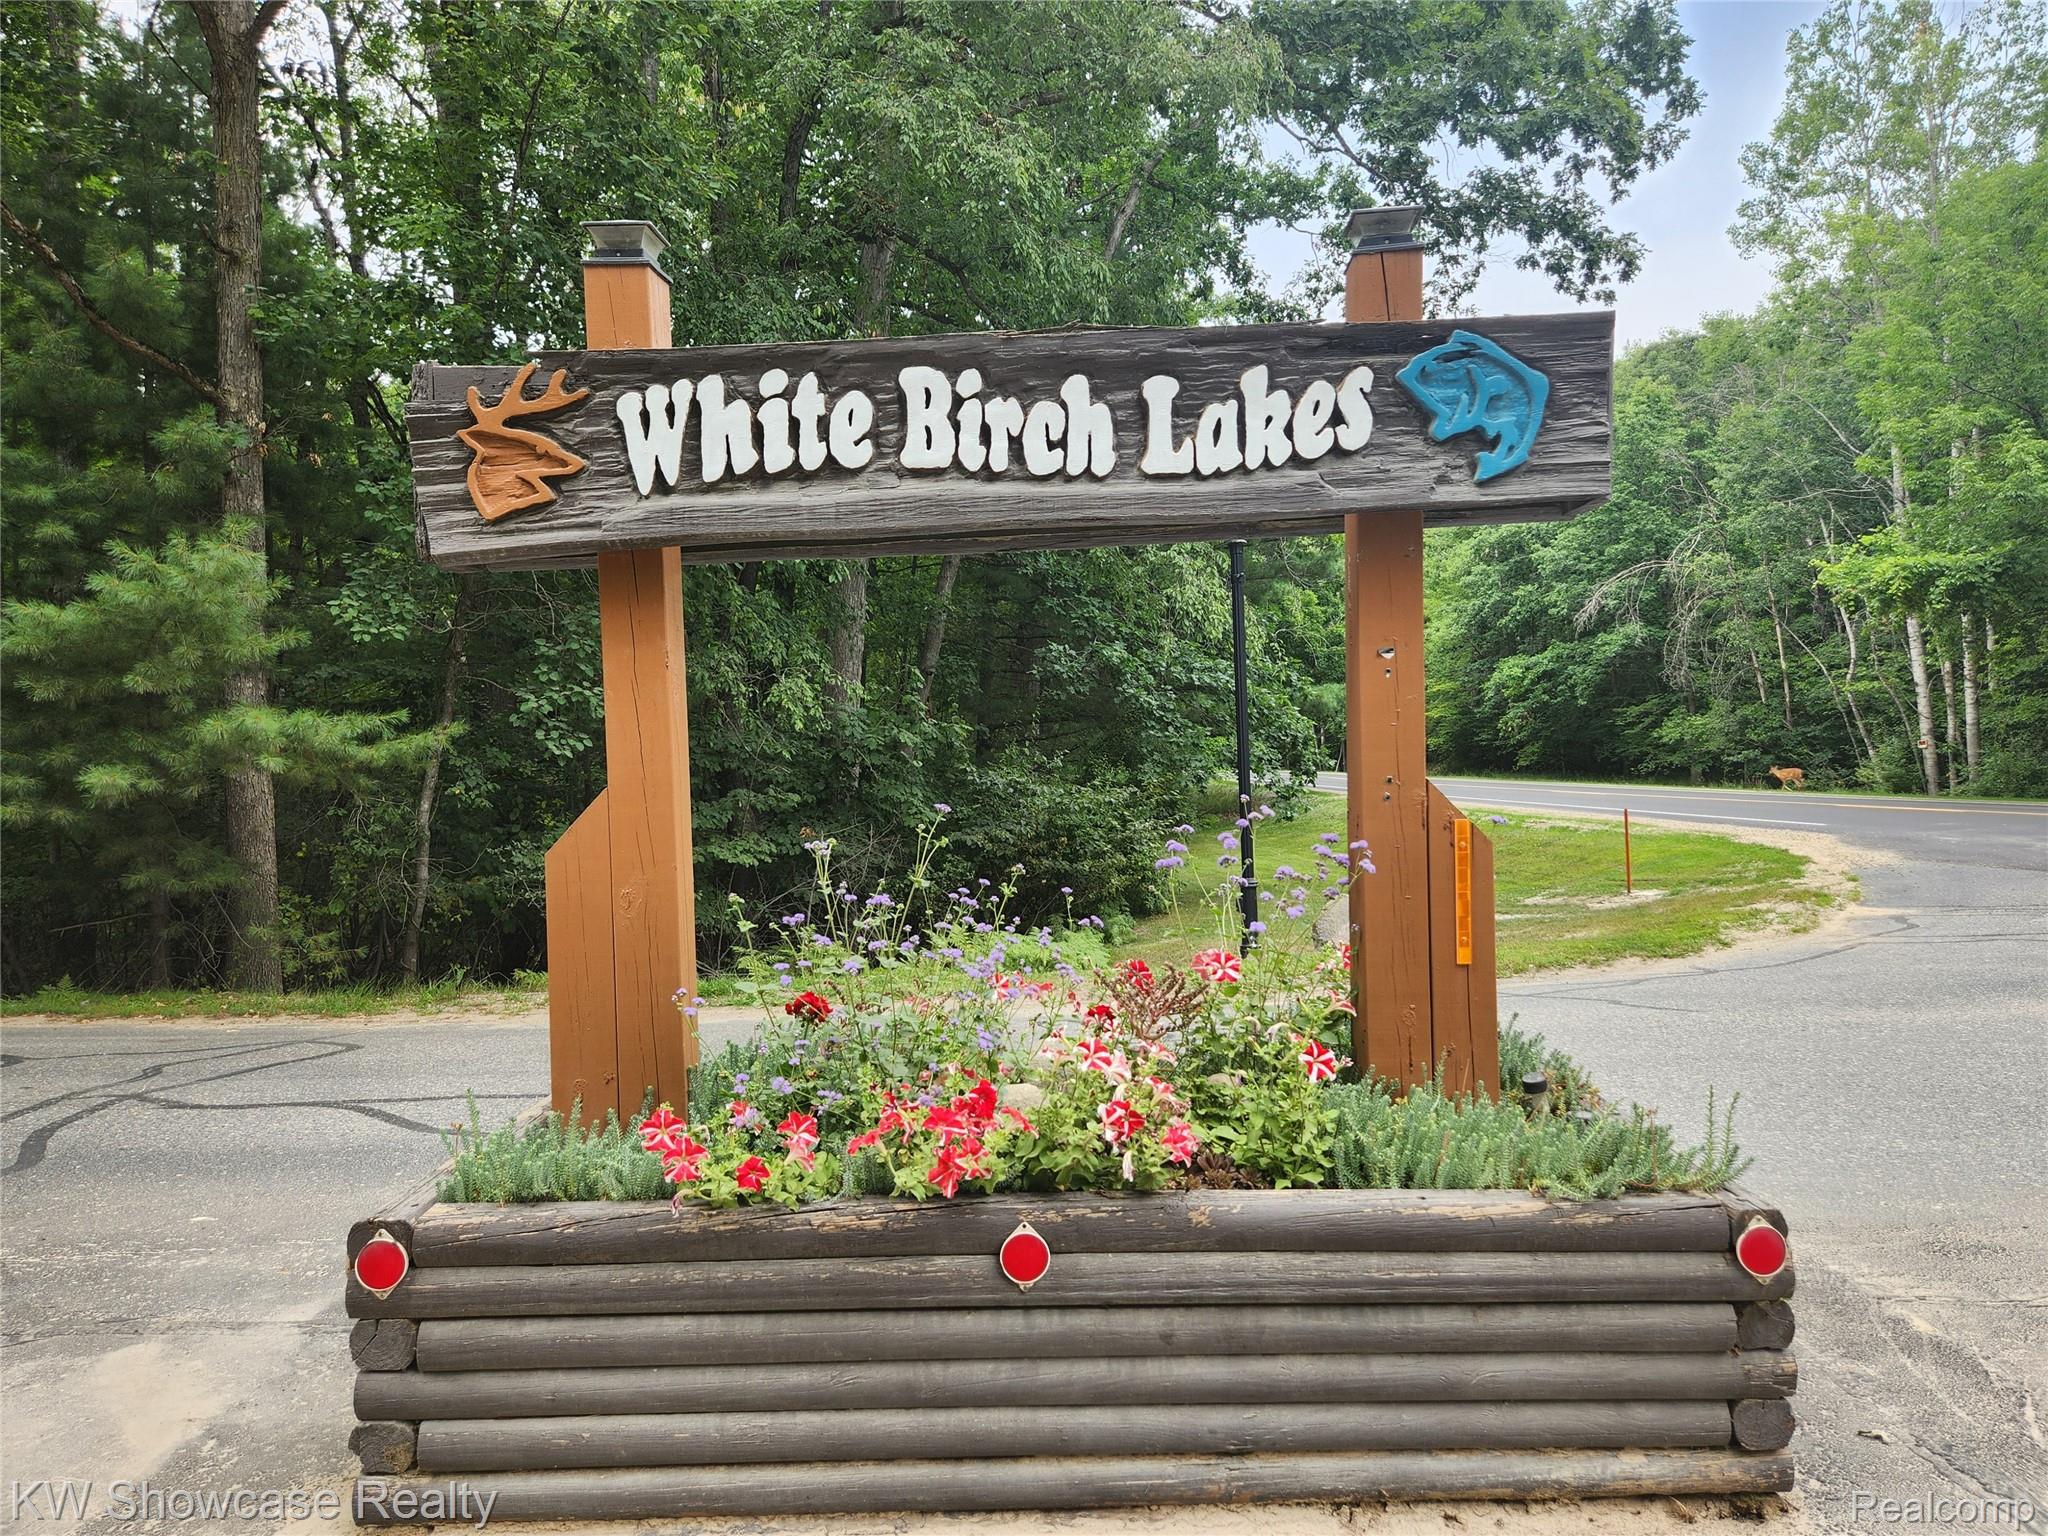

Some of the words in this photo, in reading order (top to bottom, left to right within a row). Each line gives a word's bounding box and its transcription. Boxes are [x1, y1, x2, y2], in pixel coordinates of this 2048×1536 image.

[615, 368, 876, 497] White
[897, 365, 1117, 478] Birch
[1139, 364, 1375, 475] Lakes
